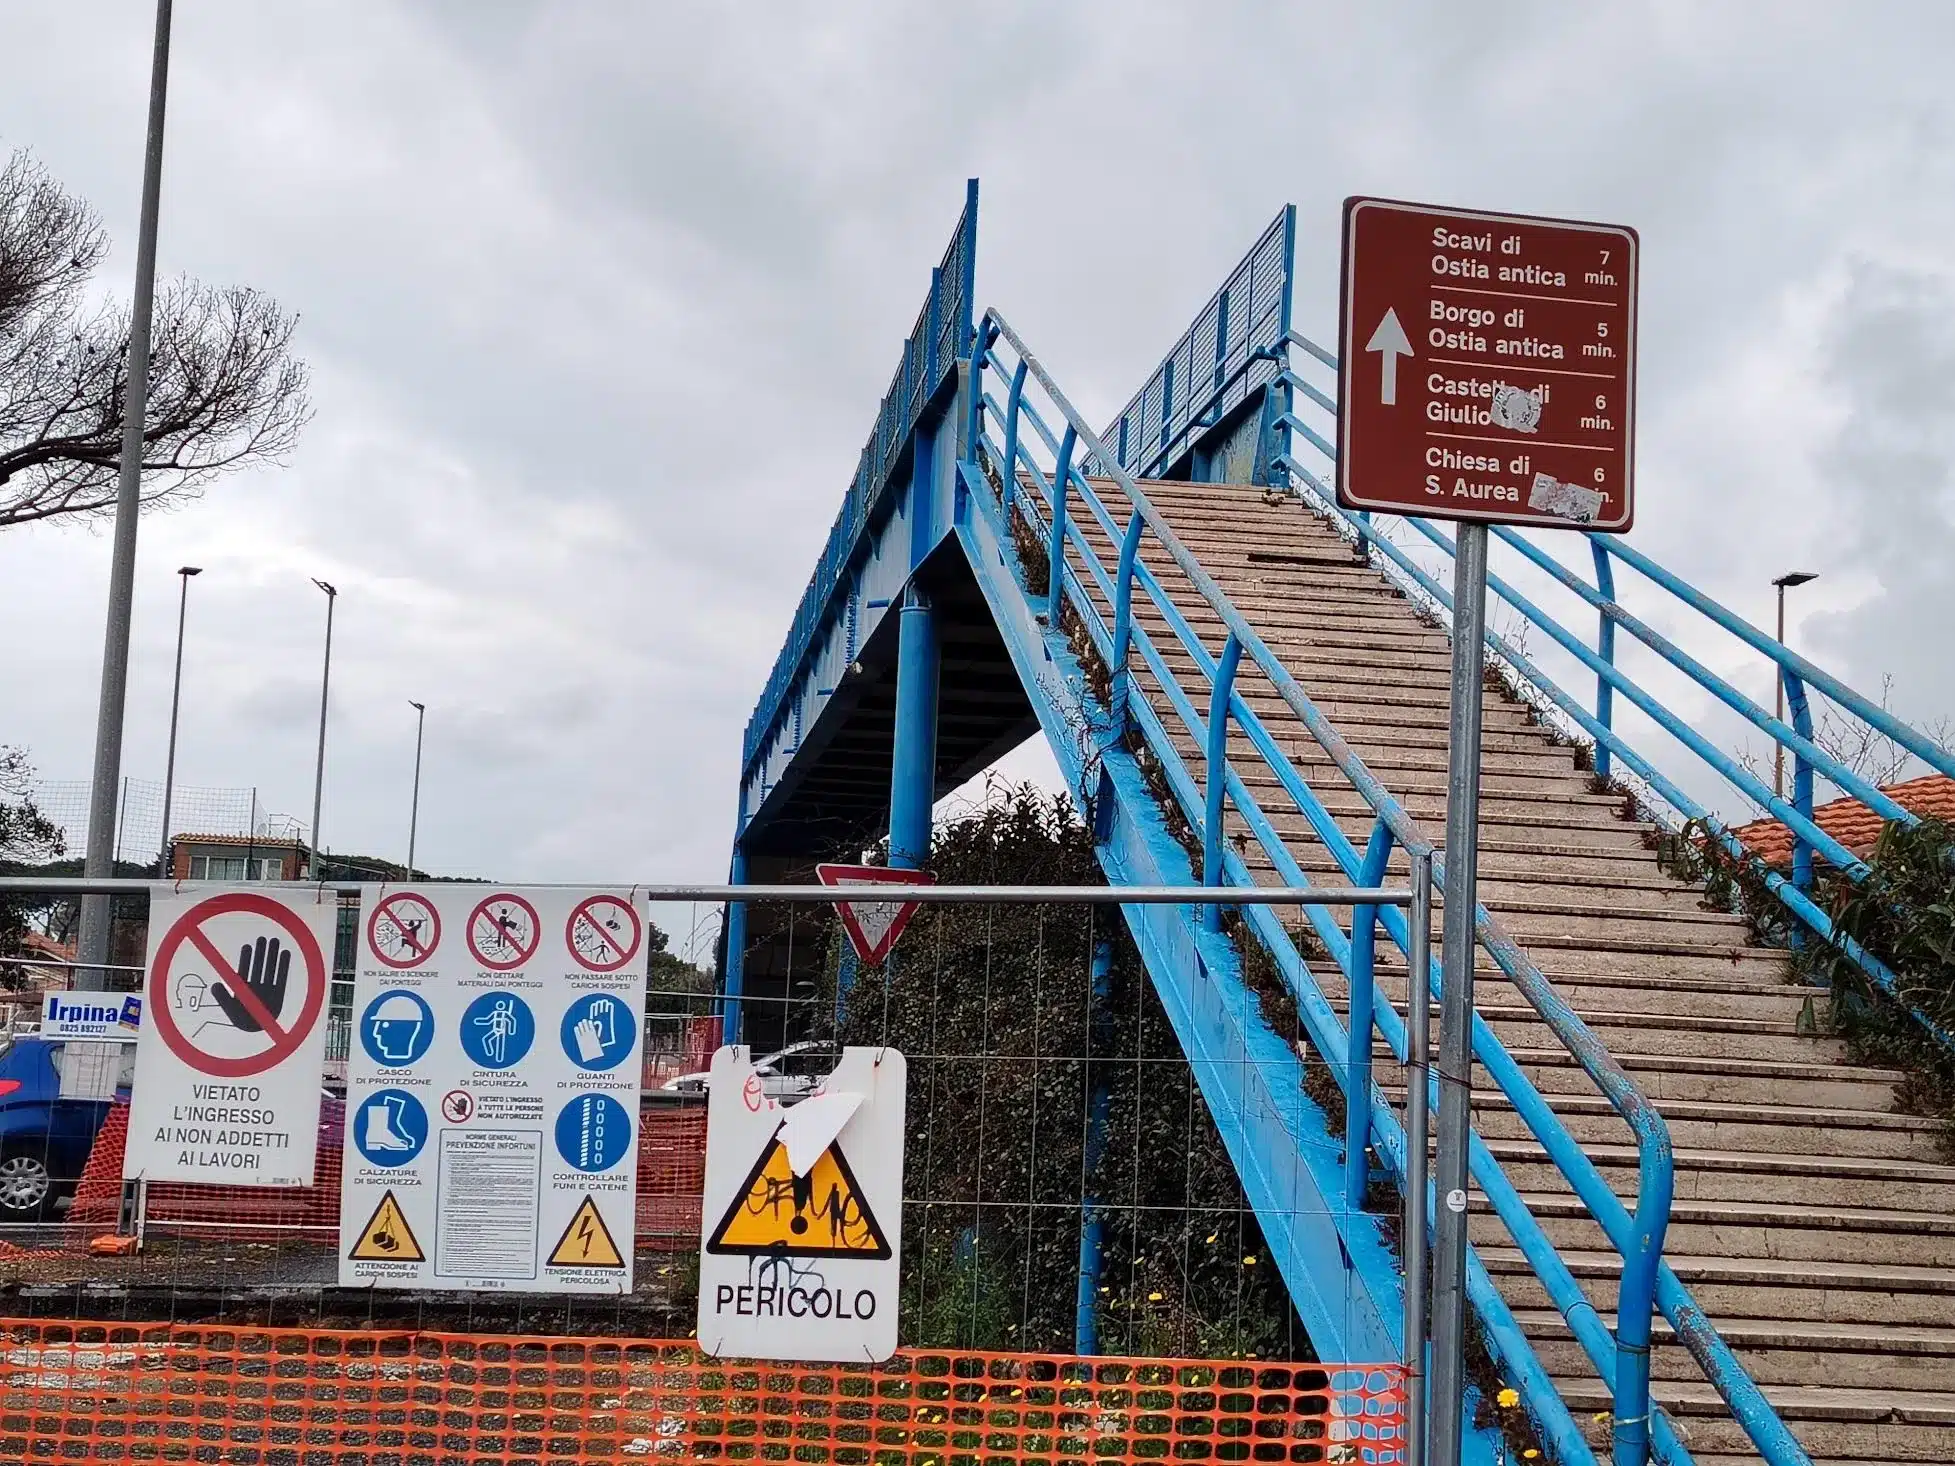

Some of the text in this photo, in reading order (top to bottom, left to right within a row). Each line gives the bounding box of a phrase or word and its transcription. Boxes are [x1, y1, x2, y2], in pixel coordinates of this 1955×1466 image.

[1432, 227, 1521, 255] Scavi di
[1599, 250, 1610, 265] 7
[1431, 255, 1566, 287] Ostia antica
[1584, 270, 1618, 286] min.
[1430, 300, 1524, 328] Borgo di
[1597, 322, 1608, 337] 5
[1428, 328, 1565, 359] Ostia antica
[1582, 343, 1617, 358] min.
[1530, 384, 1550, 404] di
[1596, 395, 1607, 410] 6
[1426, 400, 1491, 426] Giulio
[1580, 415, 1615, 431] min.
[1425, 447, 1530, 475] Chiesa di
[1594, 468, 1605, 482] 6
[1425, 475, 1444, 496] S.
[1452, 478, 1519, 502] Aurea
[48, 998, 118, 1022] Irpina
[60, 1024, 79, 1033] 0825
[368, 1078, 432, 1086] PROTEZIONE
[193, 1084, 260, 1102] VIETATO
[174, 1106, 275, 1125] L'INGRESSO
[155, 1127, 289, 1148] AI NON ADDETTI
[446, 1141, 495, 1149] PREVENZIONE
[178, 1150, 260, 1169] AI LAVORI
[355, 1263, 407, 1271] ATTENZIONE
[355, 1270, 418, 1279] CARICHI SOSPESI
[716, 1285, 876, 1320] PERICOLO
